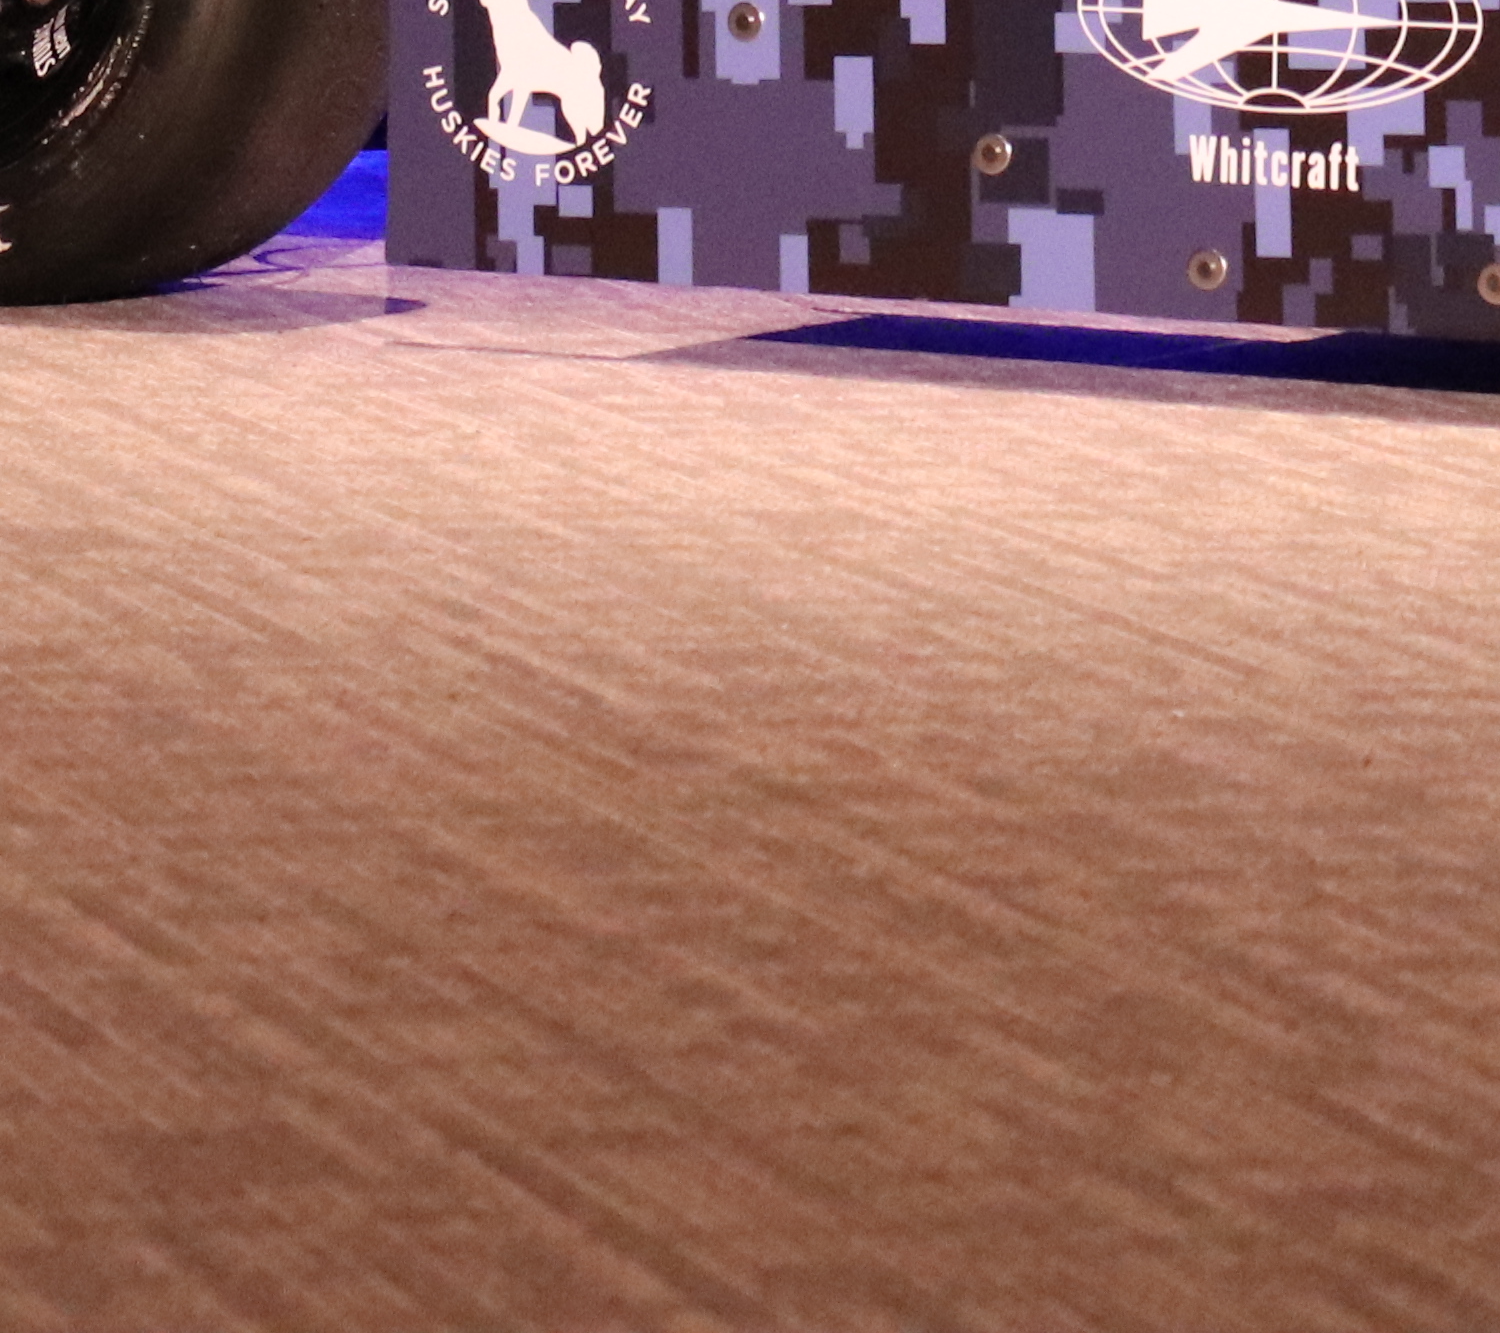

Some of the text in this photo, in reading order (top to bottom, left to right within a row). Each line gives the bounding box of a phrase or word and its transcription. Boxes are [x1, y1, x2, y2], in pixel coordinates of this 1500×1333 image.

[422, 65, 652, 187] HUSKIES FOREVER
[1187, 134, 1360, 191] Whitcraft
